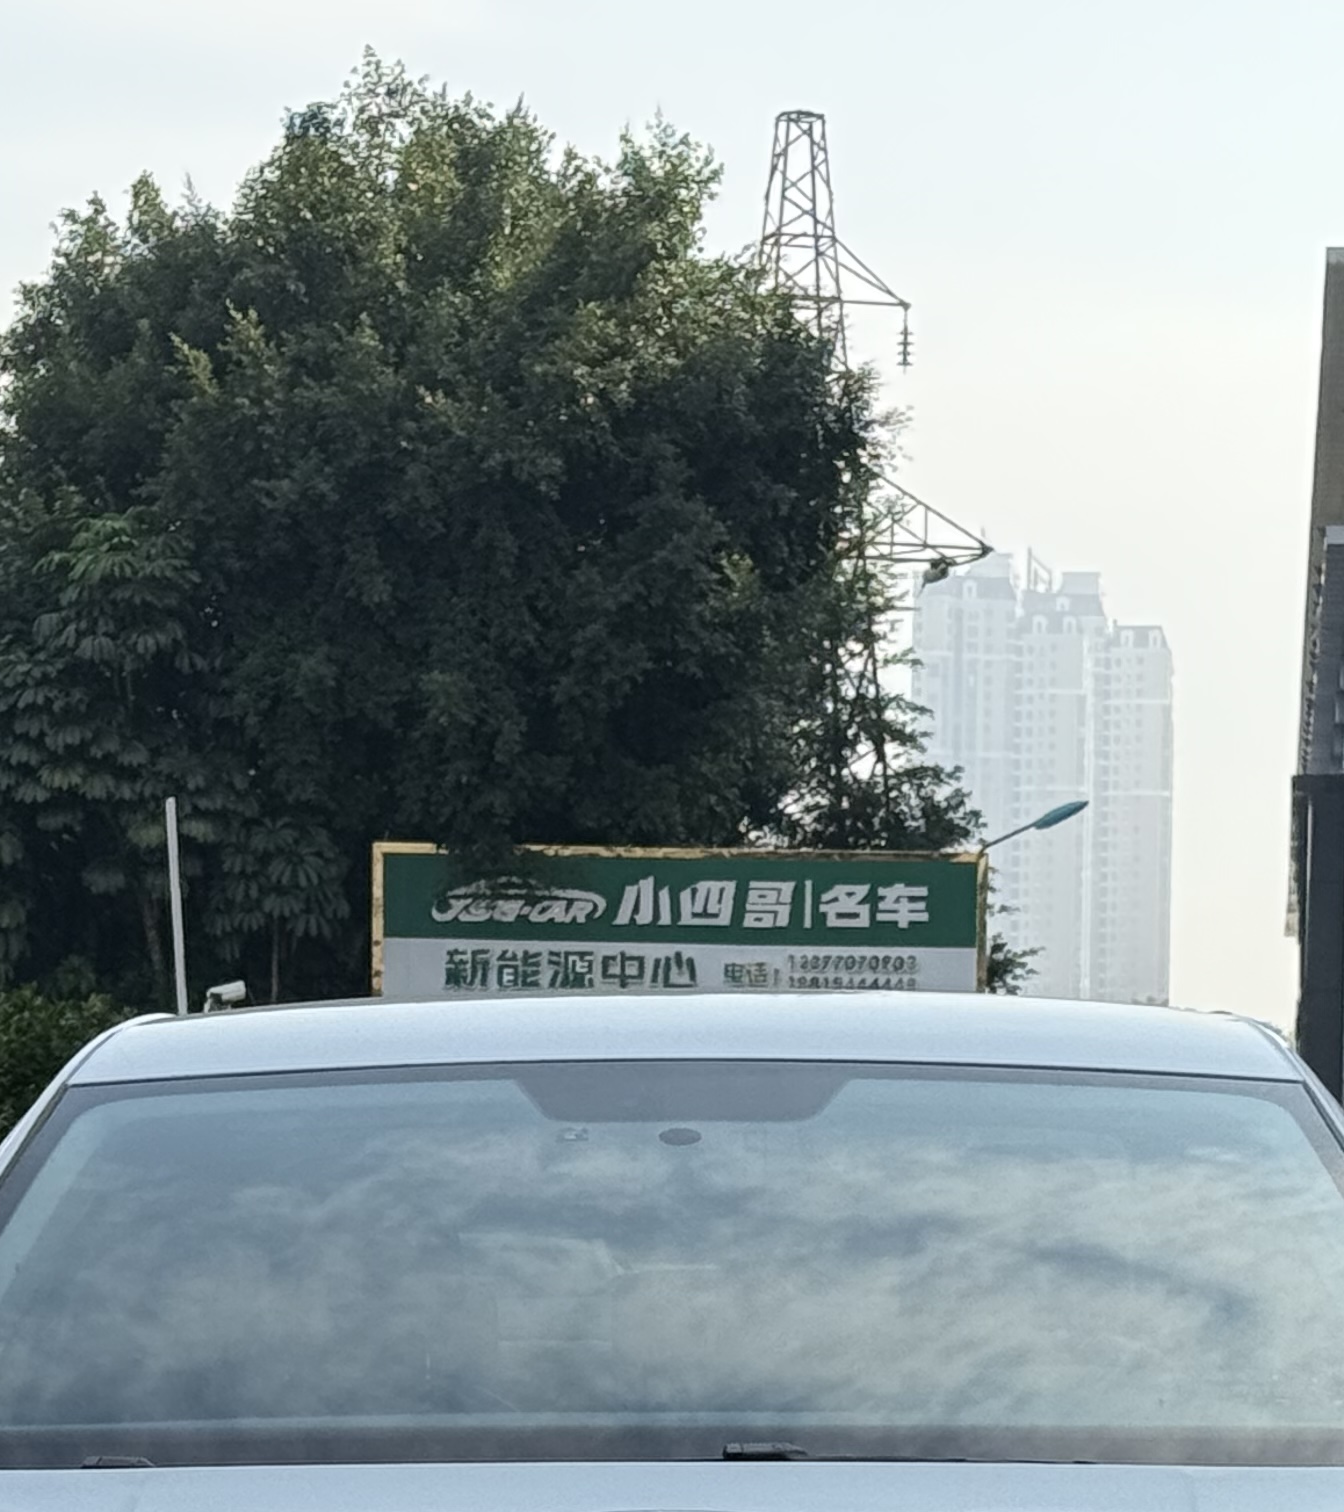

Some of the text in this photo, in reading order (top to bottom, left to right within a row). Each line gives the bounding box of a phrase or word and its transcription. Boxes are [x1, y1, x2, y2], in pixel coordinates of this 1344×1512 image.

[612, 876, 931, 929] 小四哥 名车
[444, 948, 697, 989] 新能源中心
